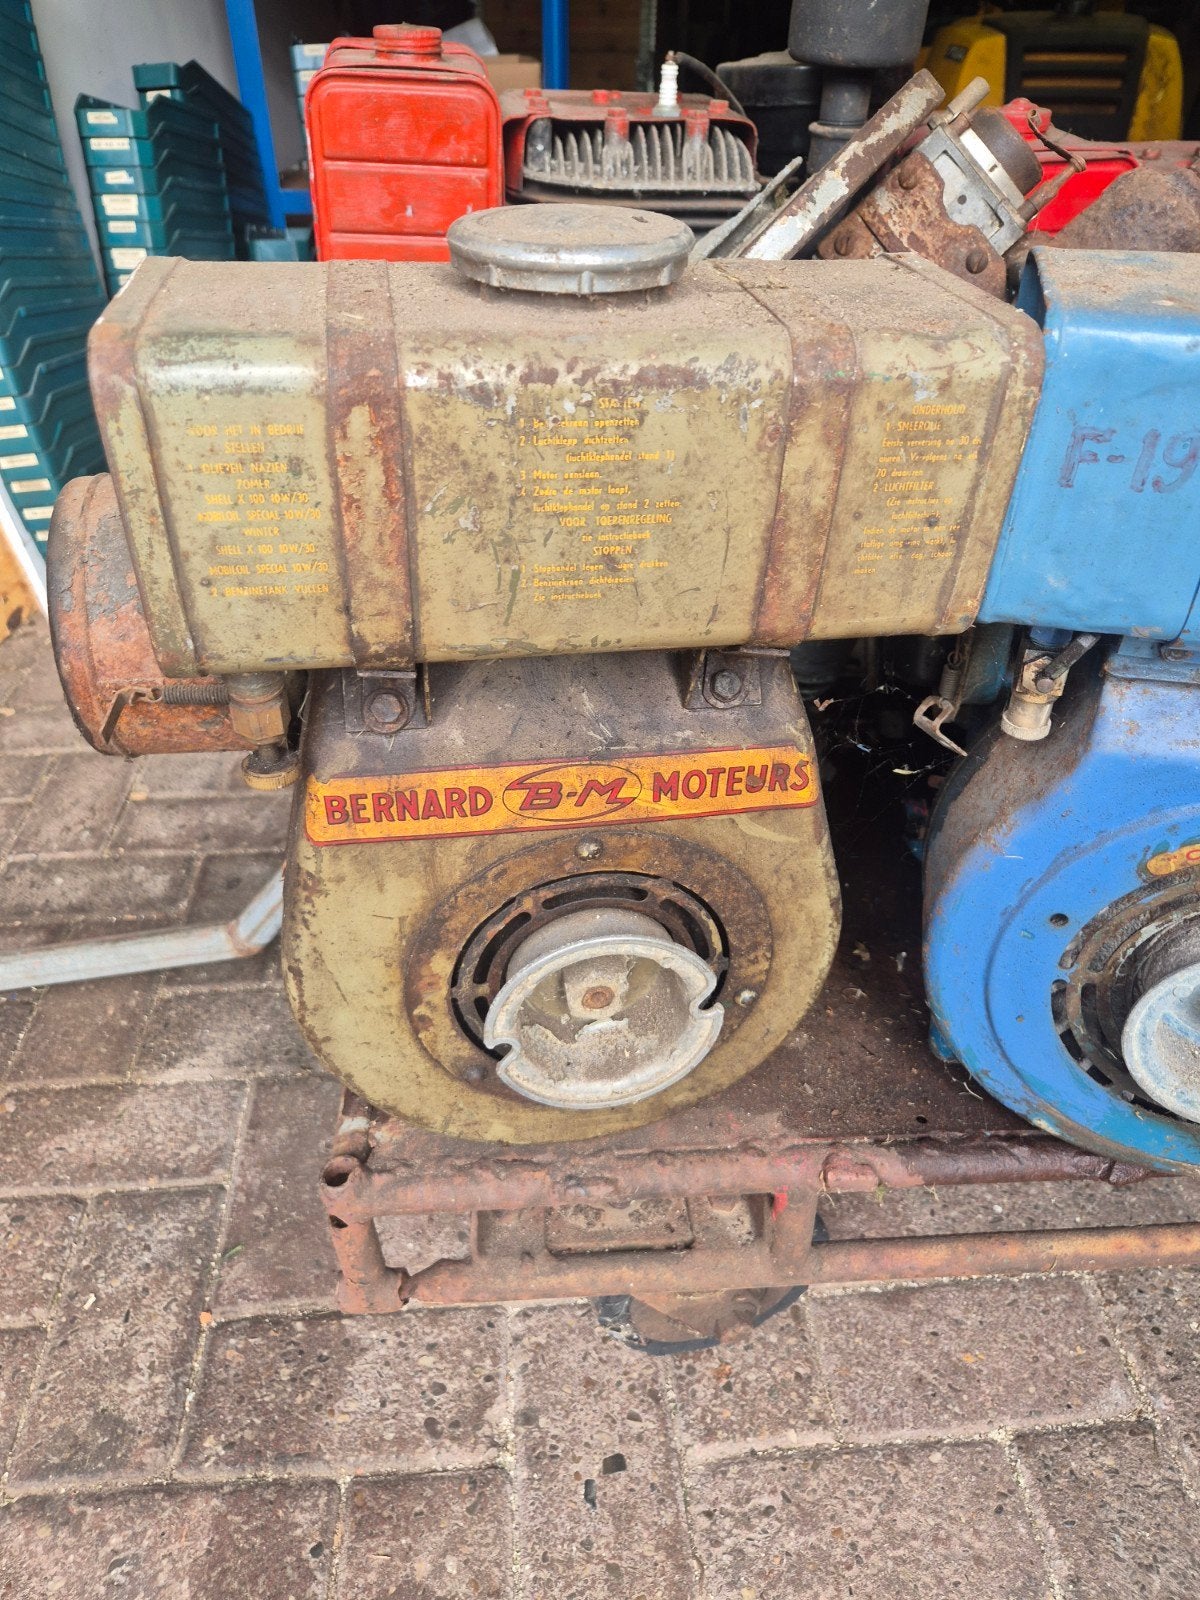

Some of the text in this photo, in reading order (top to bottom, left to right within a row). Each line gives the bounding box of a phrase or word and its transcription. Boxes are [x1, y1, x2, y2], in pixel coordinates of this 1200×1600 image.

[912, 404, 966, 415] ONDERHOUD
[250, 424, 261, 436] IN
[266, 423, 304, 437] BEDRIJF
[594, 418, 640, 430] openzetten
[583, 435, 629, 446] dichtzetten
[959, 435, 970, 446] 30
[224, 442, 264, 454] STELLEN
[639, 451, 660, 462] stand
[250, 462, 288, 474] NAZIEN
[533, 470, 558, 481] Motor
[237, 479, 270, 490] ZOMER
[533, 486, 557, 497] Zodra
[563, 485, 574, 496] de
[579, 486, 602, 496] motor
[204, 494, 232, 506] SHELL
[237, 494, 245, 505] X
[249, 494, 265, 505] 100
[600, 503, 610, 513] op
[616, 500, 638, 511] stand
[246, 509, 280, 521] SPECIAL
[560, 516, 586, 527] VOOR
[242, 526, 280, 537] WINTER
[581, 530, 651, 543] zie instructieboek
[215, 545, 241, 556] SHELL
[247, 545, 255, 555] X
[258, 544, 274, 555] 100
[593, 545, 632, 556] STOPPEN
[208, 564, 251, 576] MOBILOIL
[256, 562, 288, 575] SPECIAL
[534, 563, 577, 575] Stophandel
[582, 563, 604, 574] tegen
[533, 577, 584, 589] Benzinekraan
[224, 585, 288, 597] BENZINETANK
[551, 590, 602, 602] instructieboek
[323, 785, 494, 826] BERNARD
[652, 759, 810, 803] MOTEURS
